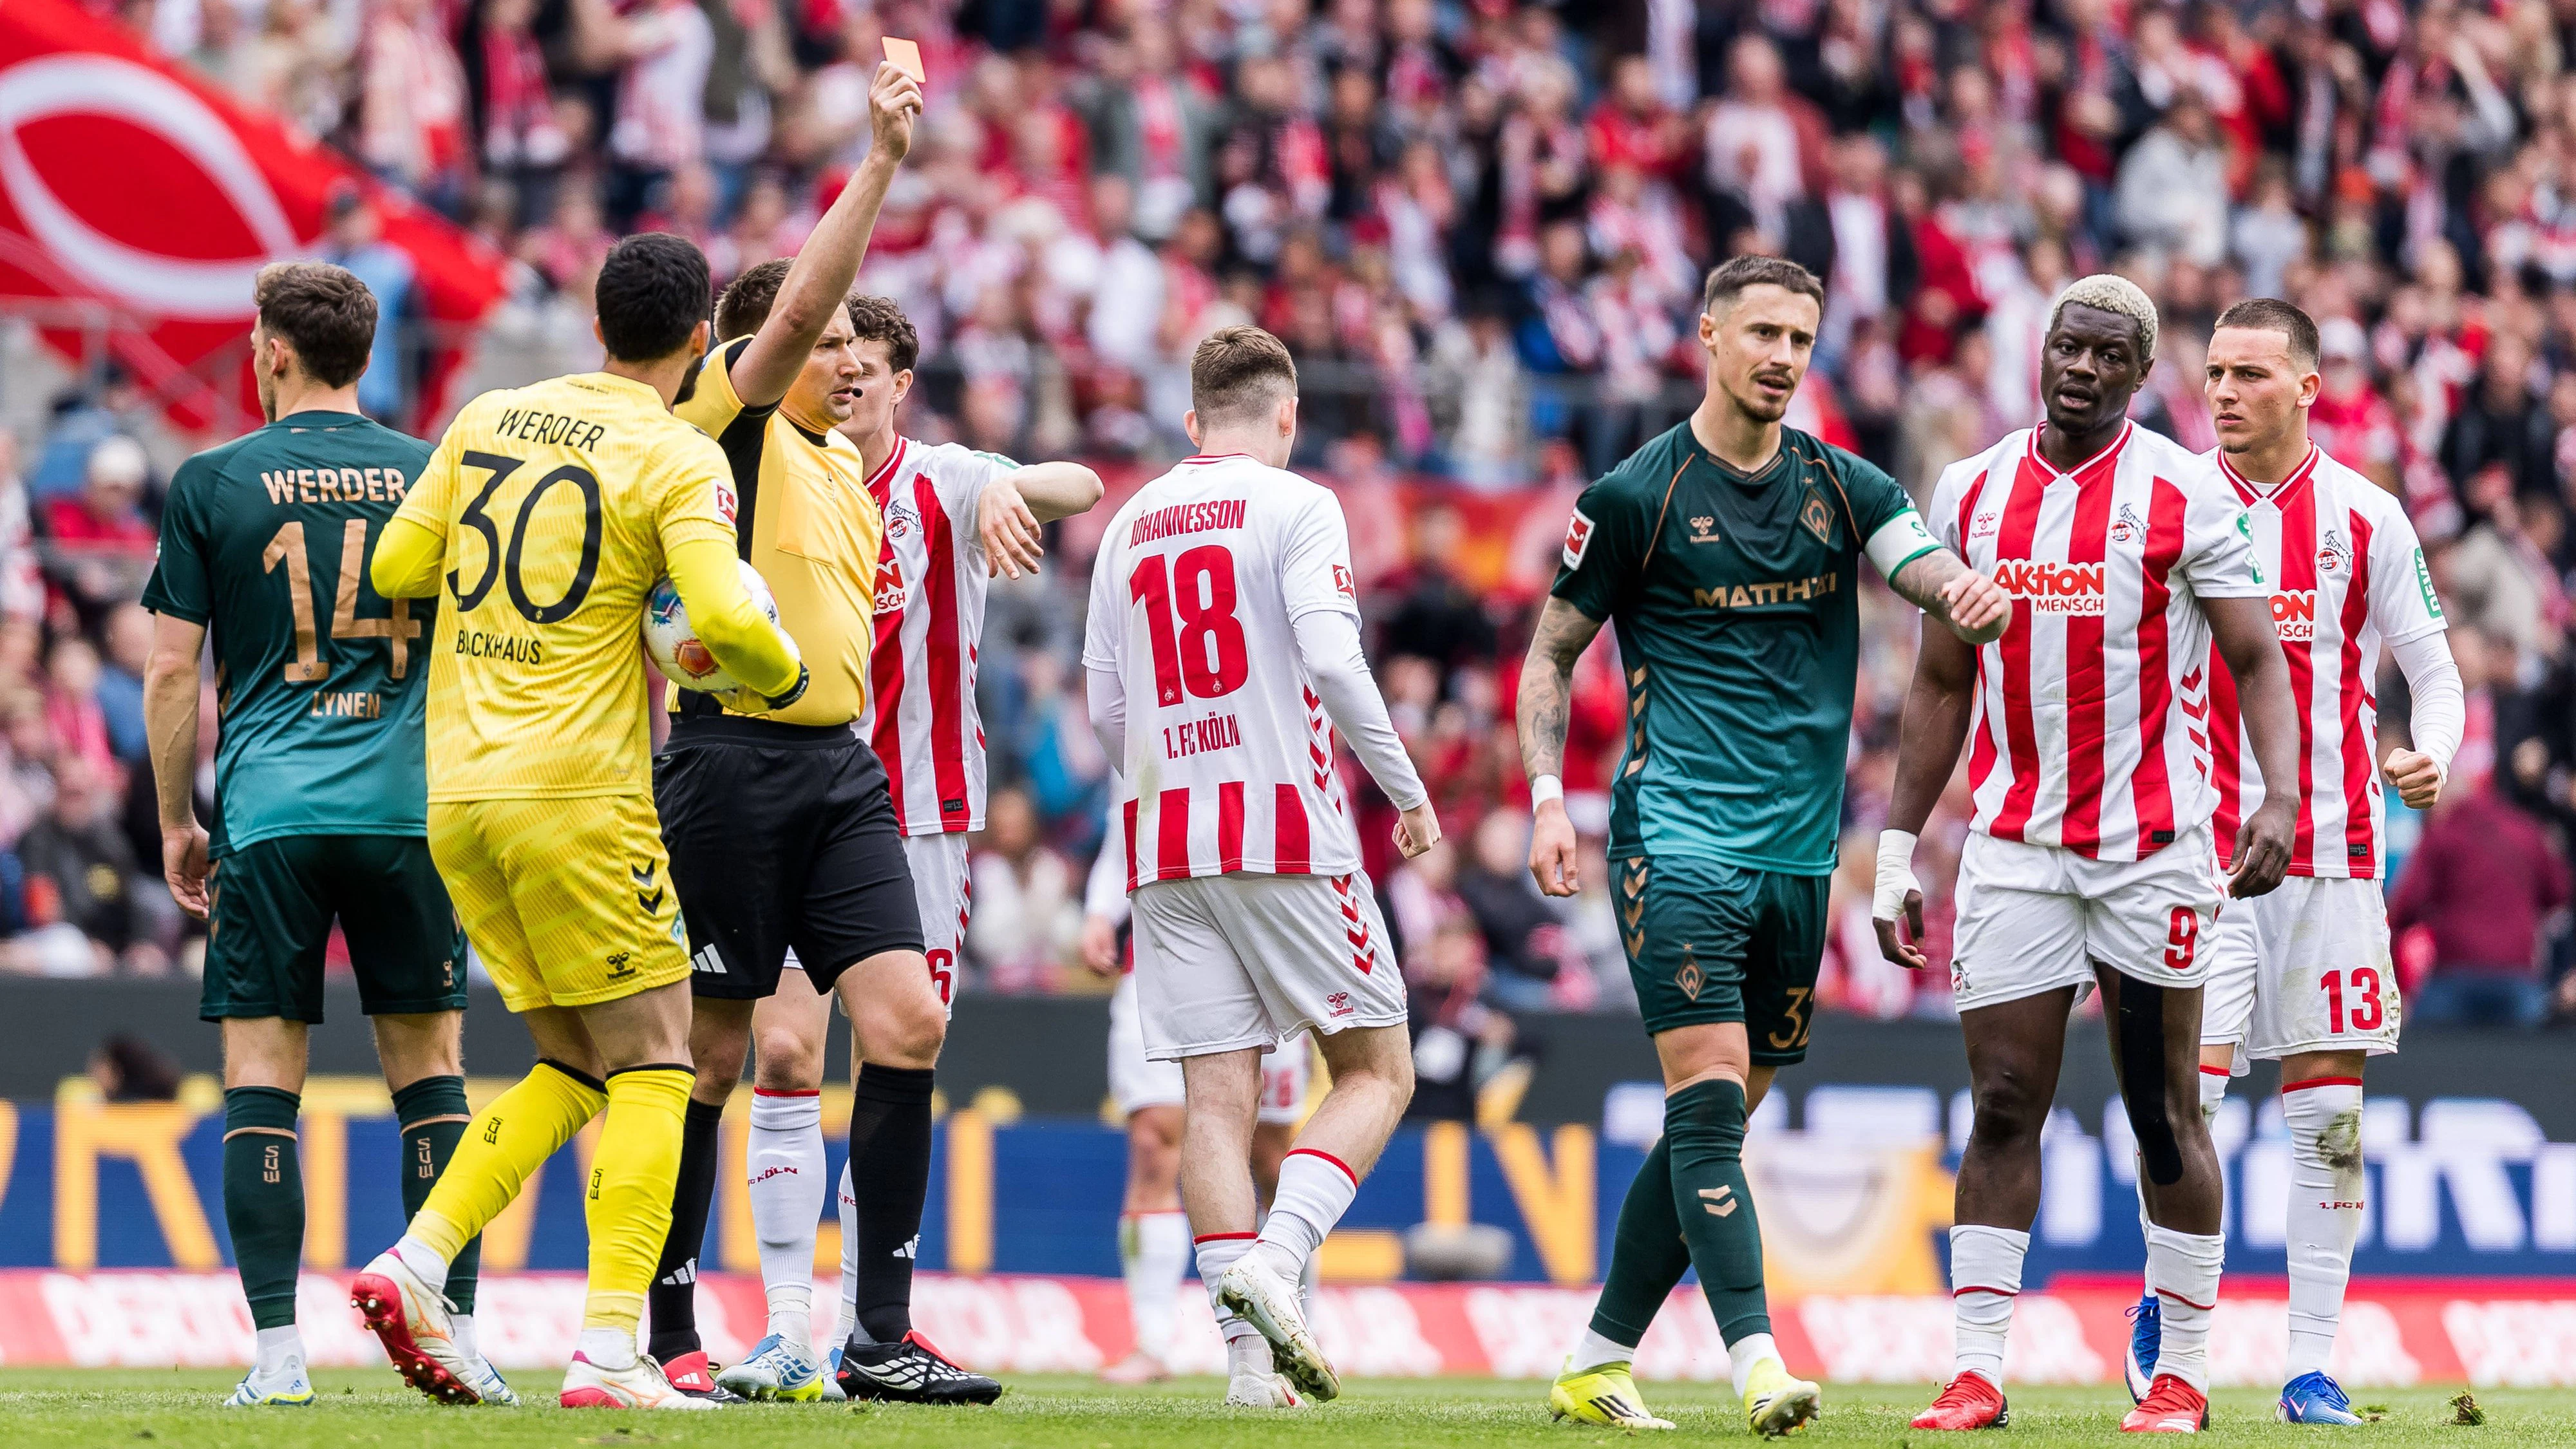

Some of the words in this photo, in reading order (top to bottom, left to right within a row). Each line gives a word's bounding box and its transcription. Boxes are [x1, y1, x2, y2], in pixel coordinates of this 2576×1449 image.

[497, 408, 605, 453] WERDER
[261, 468, 407, 505] WERDER
[447, 450, 600, 624] 30
[1128, 500, 1247, 550] JÓHANNESSON
[1971, 529, 1996, 539] hummel
[262, 518, 421, 683] 14
[874, 591, 905, 611] SCH
[2035, 598, 2105, 612] MENSCH
[1130, 545, 1248, 708] 18
[311, 690, 381, 719] LYNEN
[1163, 727, 1178, 760] 1.
[1178, 722, 1196, 757] FC
[1196, 711, 1241, 753] KÖLN
[2164, 905, 2198, 969] 9
[925, 948, 953, 1006] 6
[2320, 967, 2383, 1034] 13
[757, 1166, 799, 1183] KÖLN
[2333, 1201, 2353, 1209] FC
